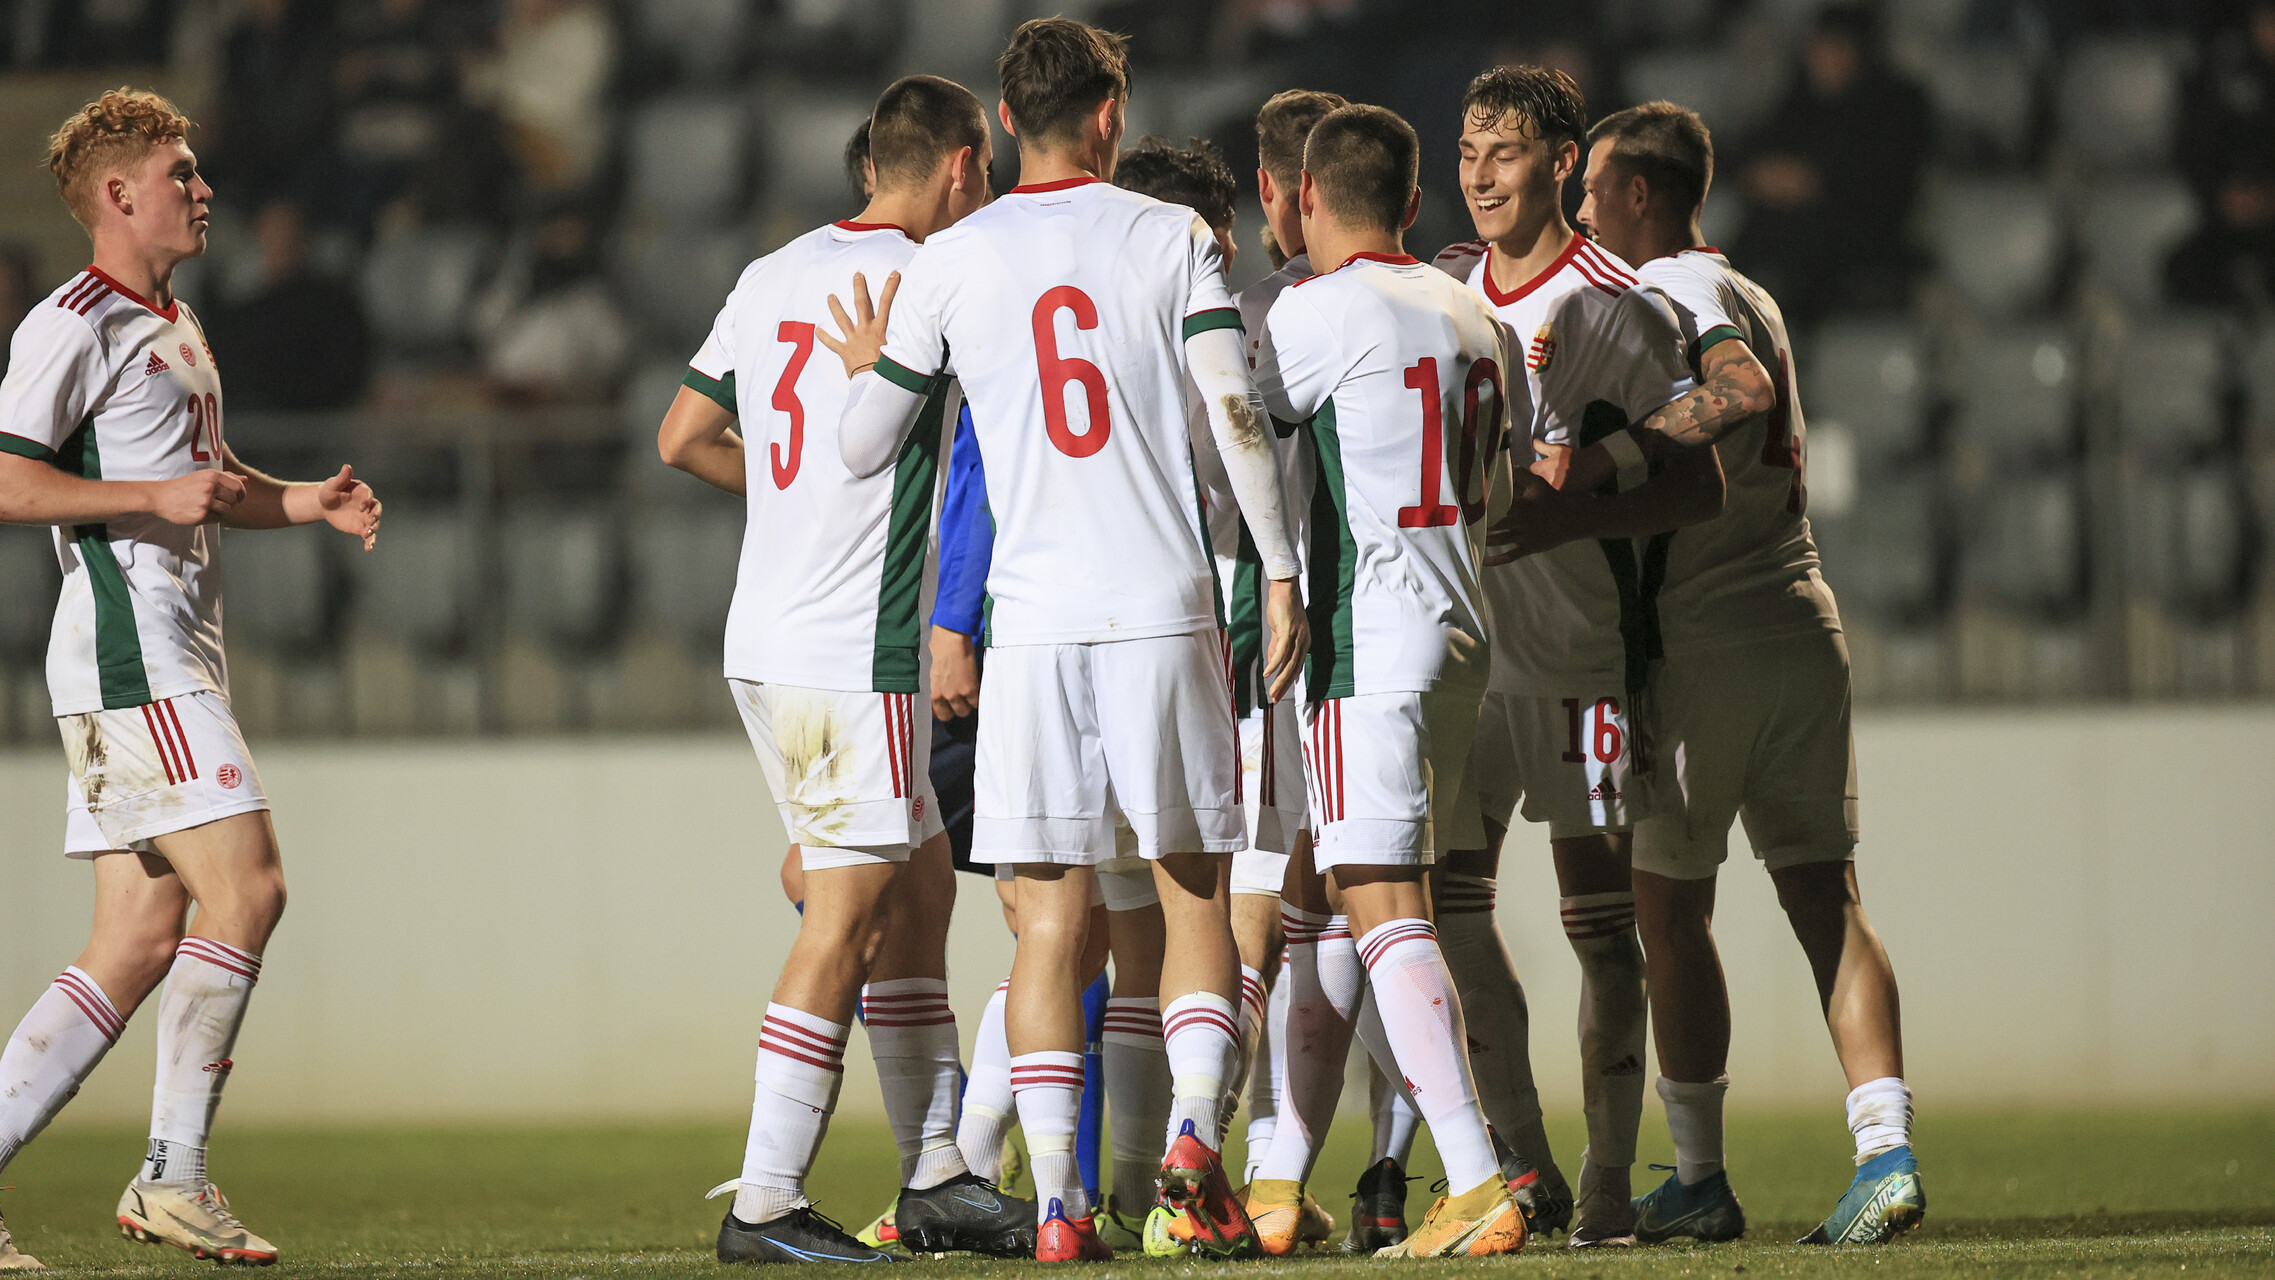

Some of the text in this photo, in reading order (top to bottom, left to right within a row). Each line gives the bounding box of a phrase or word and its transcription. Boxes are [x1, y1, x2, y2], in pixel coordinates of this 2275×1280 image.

[144, 363, 170, 376] adidas
[1032, 285, 1111, 458] 6
[187, 392, 221, 462] 20
[770, 320, 815, 490] 3
[1398, 357, 1504, 528] 10
[1562, 696, 1621, 764] 16
[1588, 791, 1622, 801] adidas
